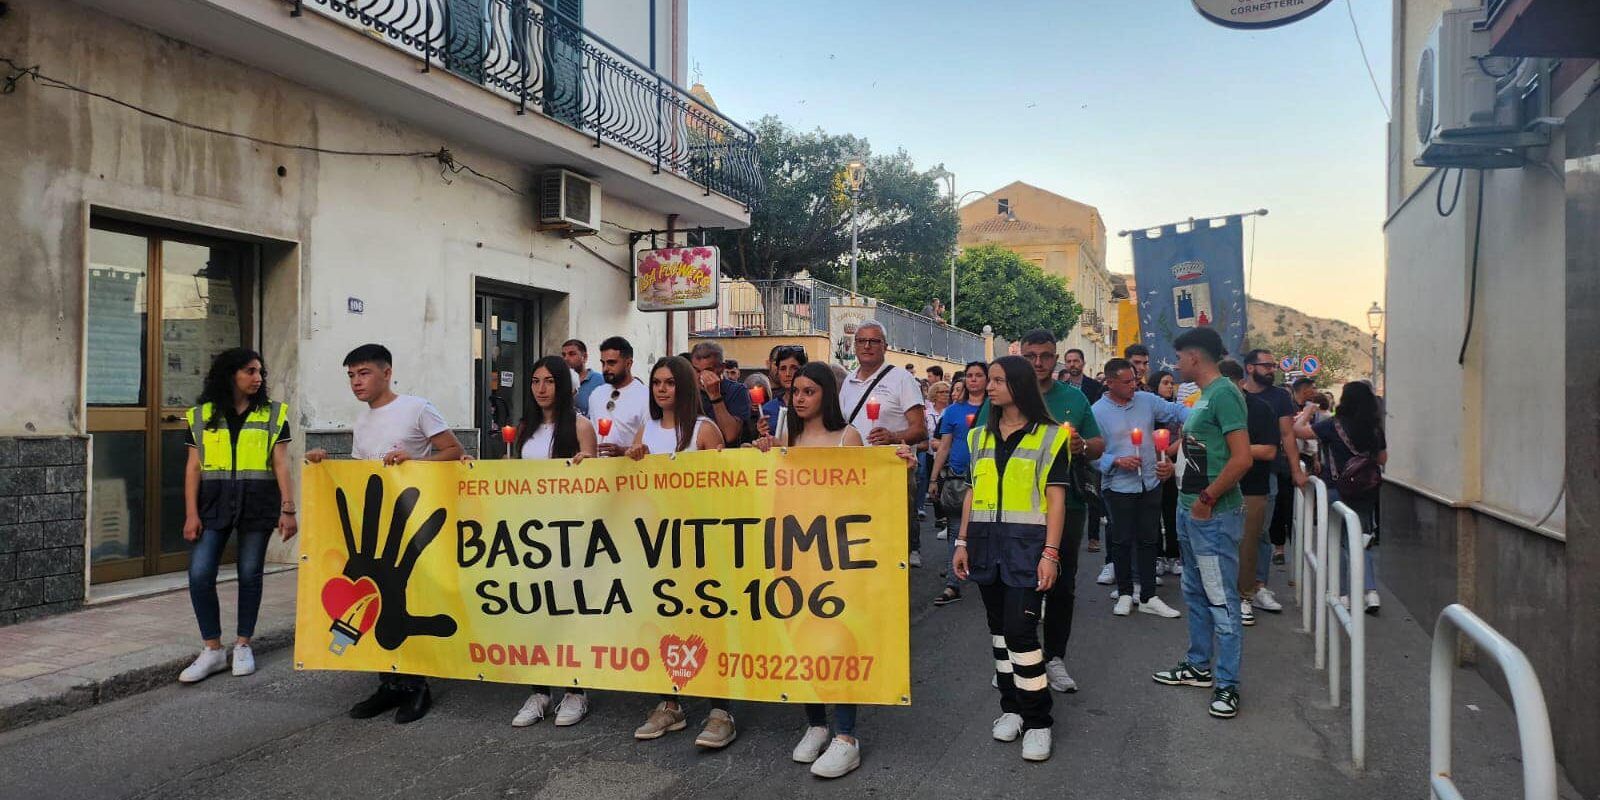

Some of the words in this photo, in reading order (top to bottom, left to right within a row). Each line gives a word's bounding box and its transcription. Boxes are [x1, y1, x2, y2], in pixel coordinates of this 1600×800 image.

[1230, 0, 1305, 15] CORNETTERIA
[658, 262, 712, 289] FLOWERS
[458, 479, 489, 496] PER
[494, 478, 532, 495] UNA
[537, 476, 610, 495] STRADA
[615, 470, 649, 492] PIÙ
[654, 469, 749, 491] MODERNA
[755, 469, 768, 486] E
[774, 468, 867, 486] SICURA!
[456, 519, 621, 570] BASTA
[634, 514, 878, 571] VITTIME
[475, 578, 633, 616] SULLA
[469, 642, 550, 667] DONA
[556, 644, 582, 669] IL
[591, 645, 651, 672] TUO
[665, 643, 698, 668] 5X
[717, 652, 875, 682] 97032230787
[672, 667, 692, 678] mille
